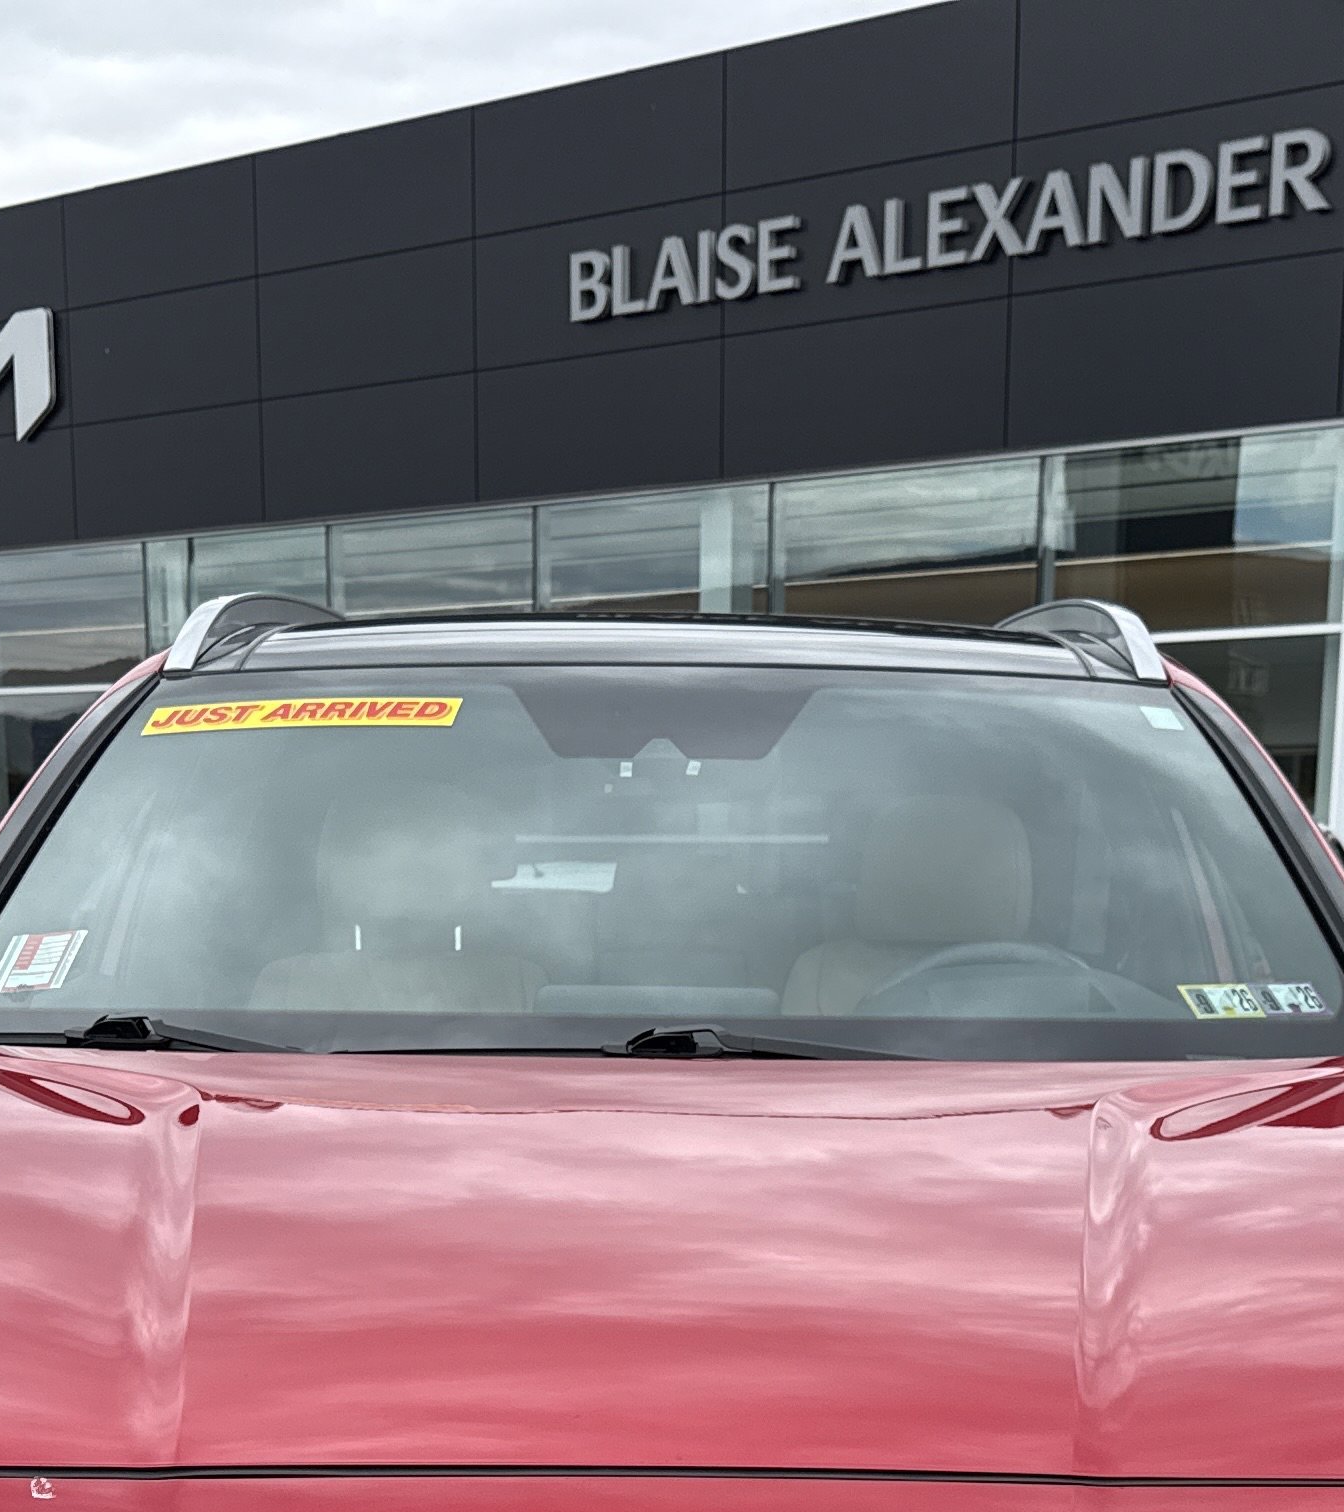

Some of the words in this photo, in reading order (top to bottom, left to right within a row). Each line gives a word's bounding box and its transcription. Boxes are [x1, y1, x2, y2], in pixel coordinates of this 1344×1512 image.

[569, 214, 801, 323] BLAISE
[824, 127, 1334, 285] ALEXANDER
[151, 704, 263, 730] JUST
[260, 700, 453, 722] ARRIVED
